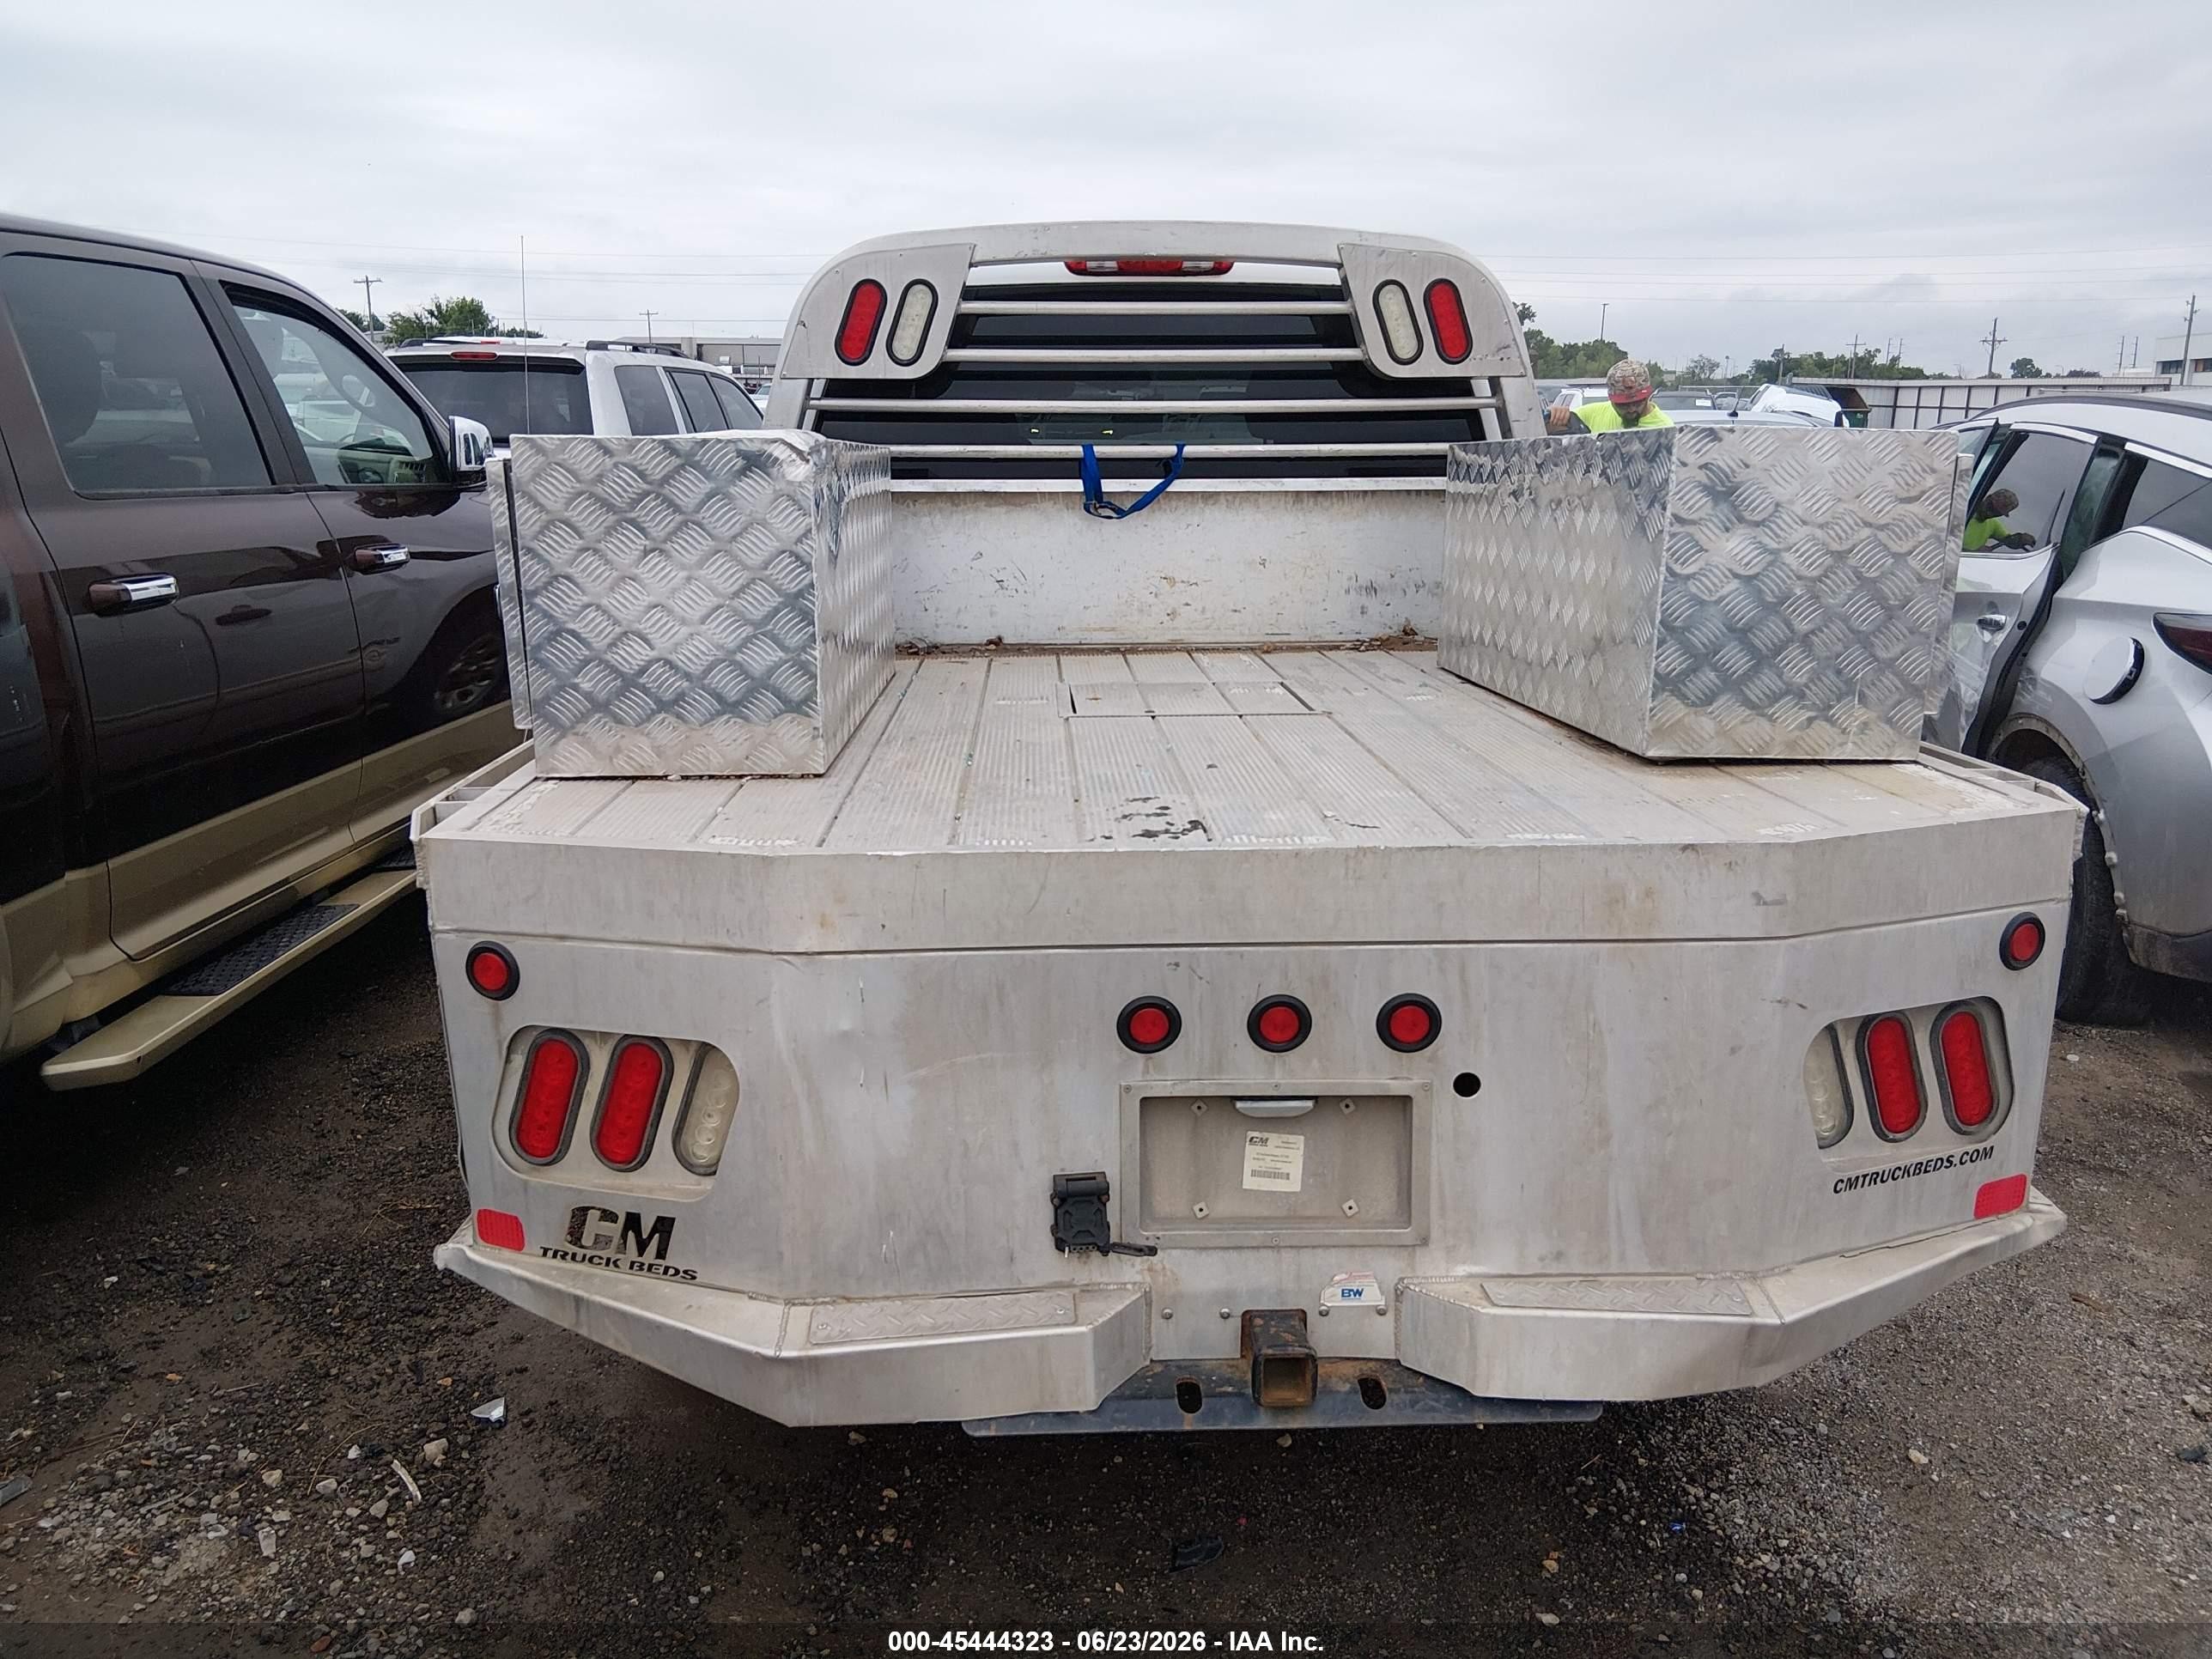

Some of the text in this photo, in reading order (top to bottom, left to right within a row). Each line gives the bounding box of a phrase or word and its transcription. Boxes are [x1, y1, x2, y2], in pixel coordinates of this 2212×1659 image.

[1832, 1145, 1995, 1194] CMTRUCKBEDS.COM
[565, 1206, 677, 1261] CM
[539, 1246, 698, 1281] TRUCK BEDS
